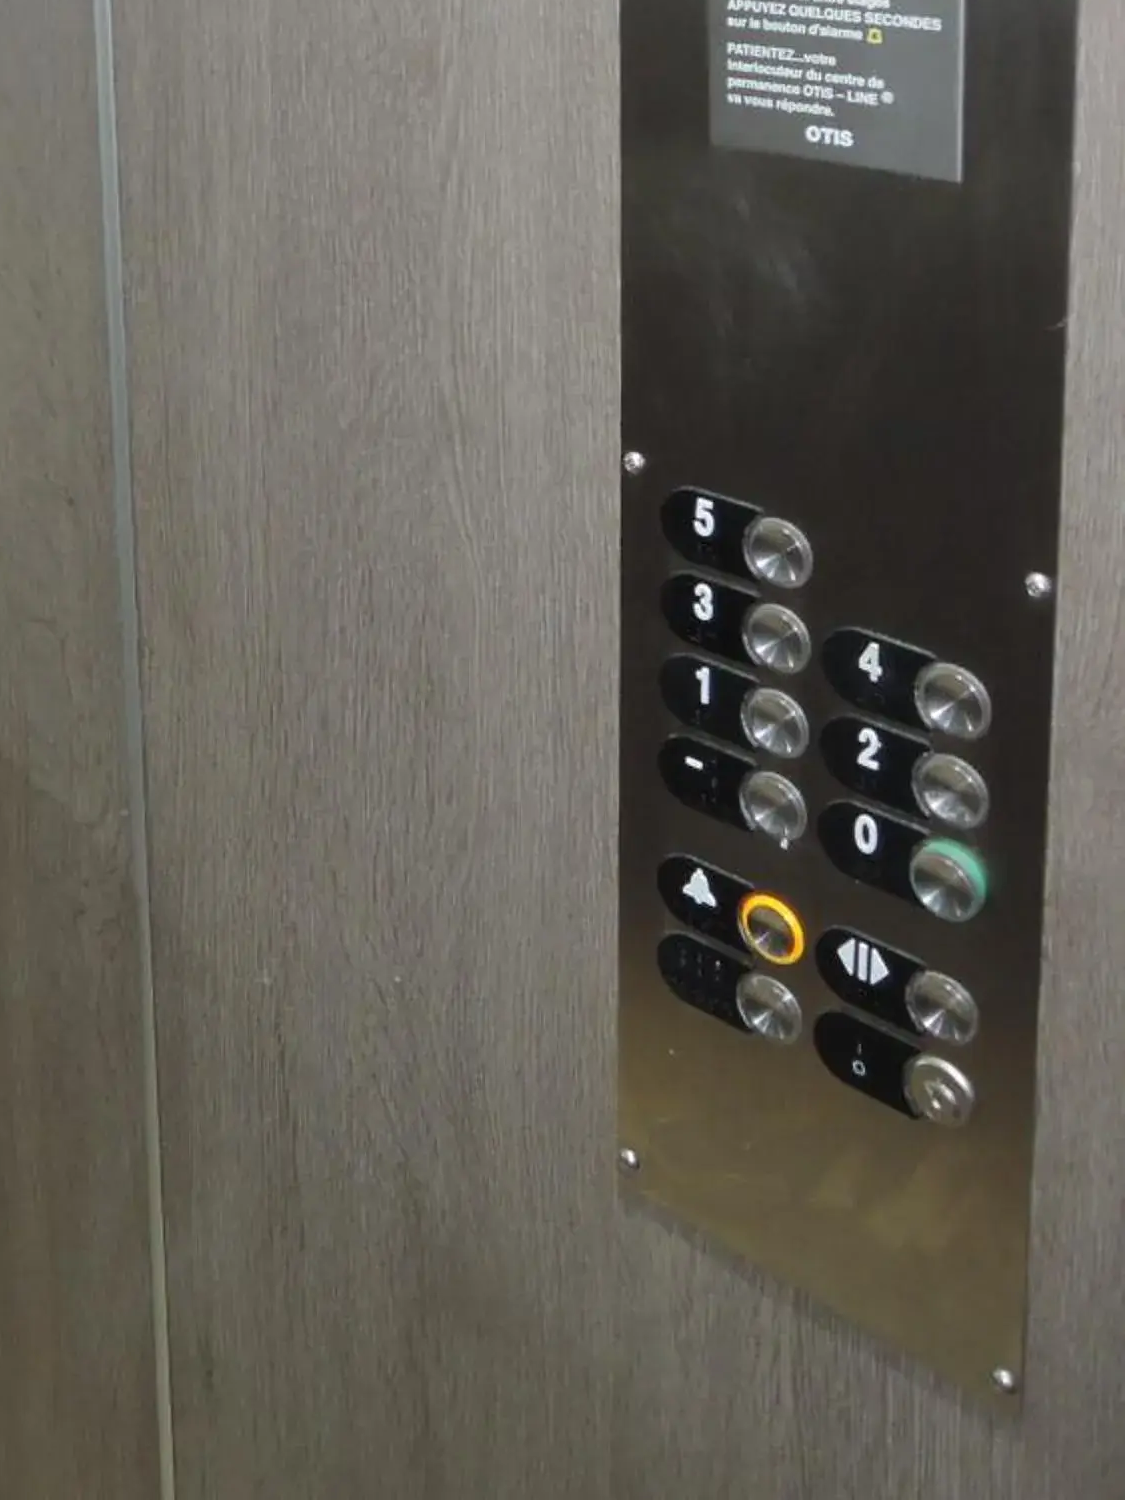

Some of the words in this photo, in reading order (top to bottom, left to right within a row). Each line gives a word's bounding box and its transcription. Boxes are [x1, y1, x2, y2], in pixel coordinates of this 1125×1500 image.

[726, 17, 746, 29] sur
[749, 18, 761, 30] le
[762, 19, 806, 35] bouton
[808, 22, 864, 41] d'alarme
[788, 4, 862, 24] QUELQUES
[864, 11, 943, 32] SECONDES
[727, 77, 801, 96] permanence
[803, 84, 835, 100] OTIS
[846, 89, 880, 106] LINE
[805, 68, 822, 82] du
[825, 72, 866, 88] centre
[868, 76, 885, 90] de
[727, 93, 742, 104] va
[743, 95, 774, 109] vous
[805, 125, 854, 148] OTIS
[692, 497, 716, 537] 5
[692, 582, 715, 622] 3
[858, 641, 884, 684] 4
[694, 666, 711, 706] 1
[855, 726, 883, 772] 2
[853, 813, 878, 856] 0
